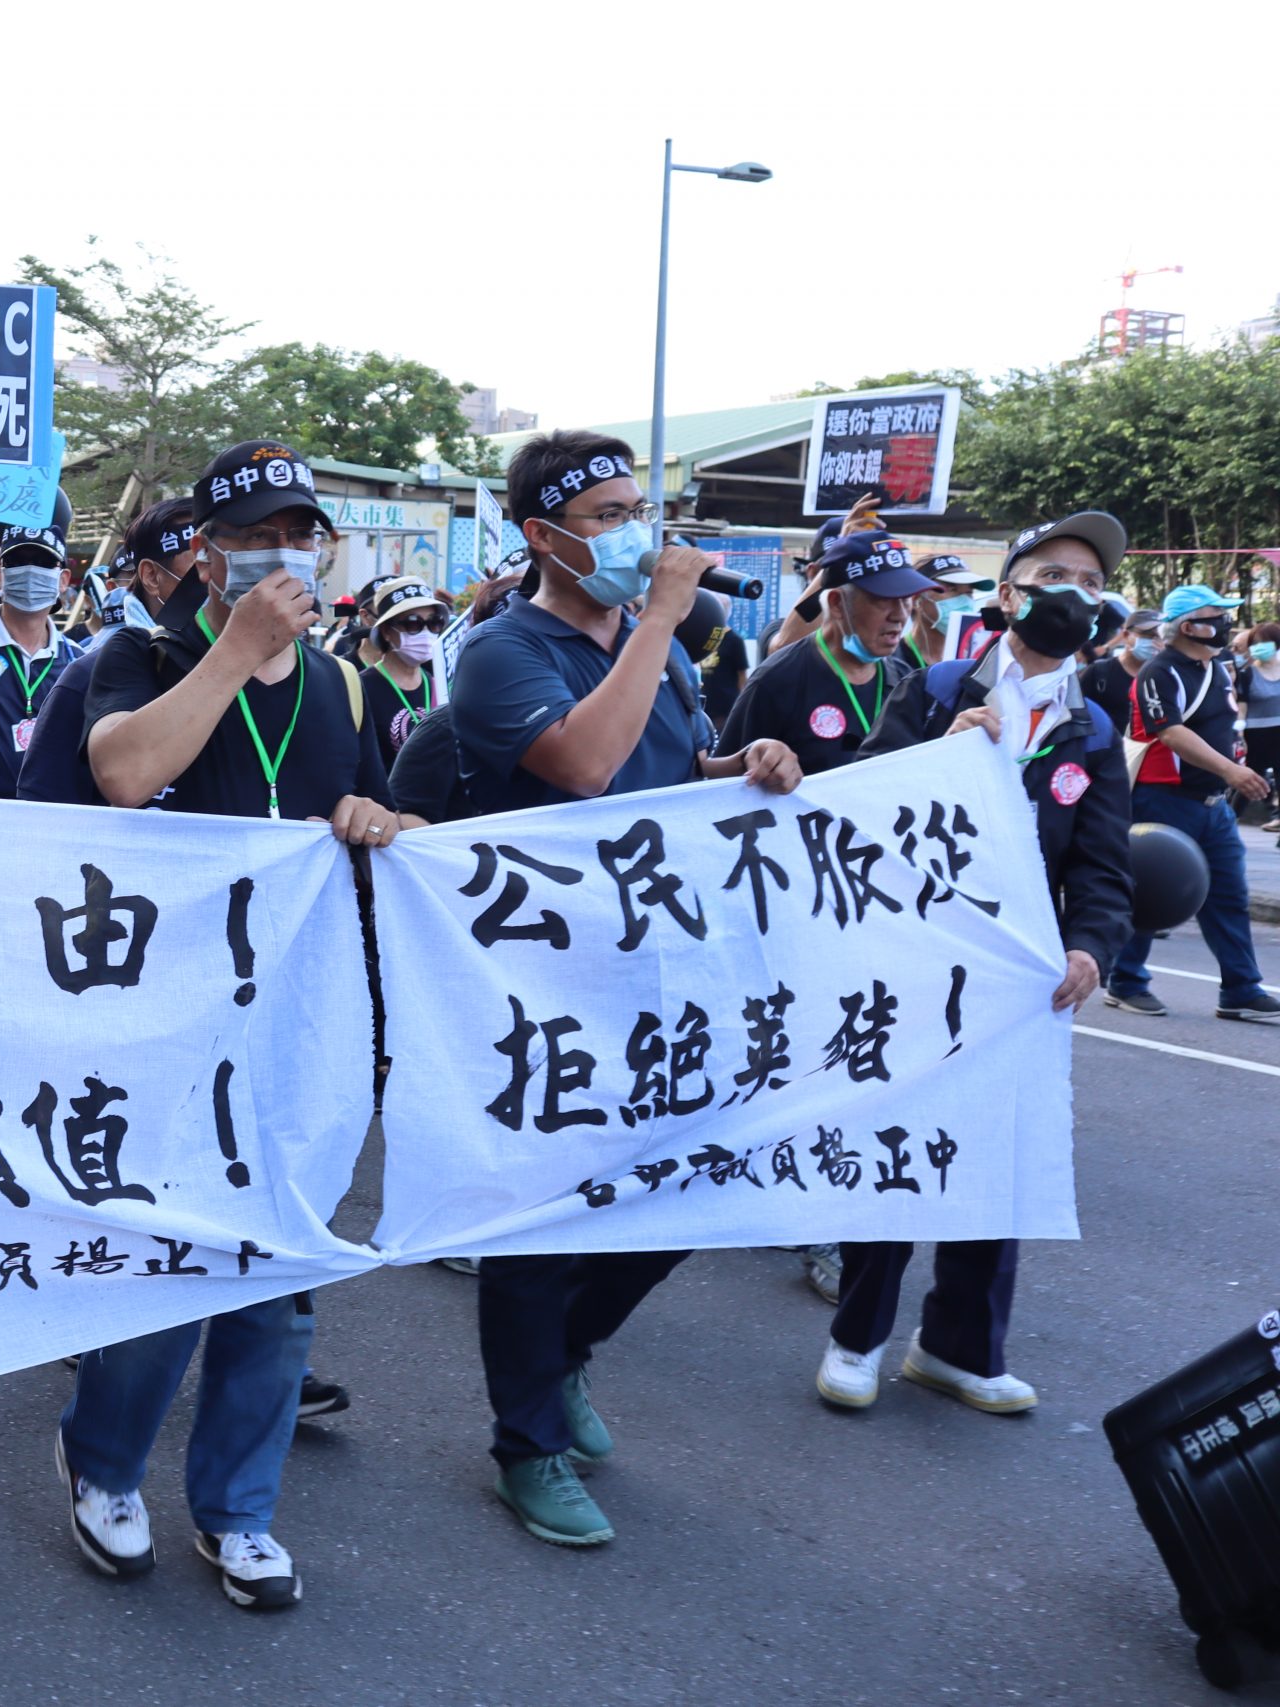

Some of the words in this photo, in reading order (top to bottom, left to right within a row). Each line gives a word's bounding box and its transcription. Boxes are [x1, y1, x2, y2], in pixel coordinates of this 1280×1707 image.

[826, 404, 941, 437] 選你當政府
[210, 459, 315, 505] 台中反毒
[458, 800, 1001, 953] 公民不服從
